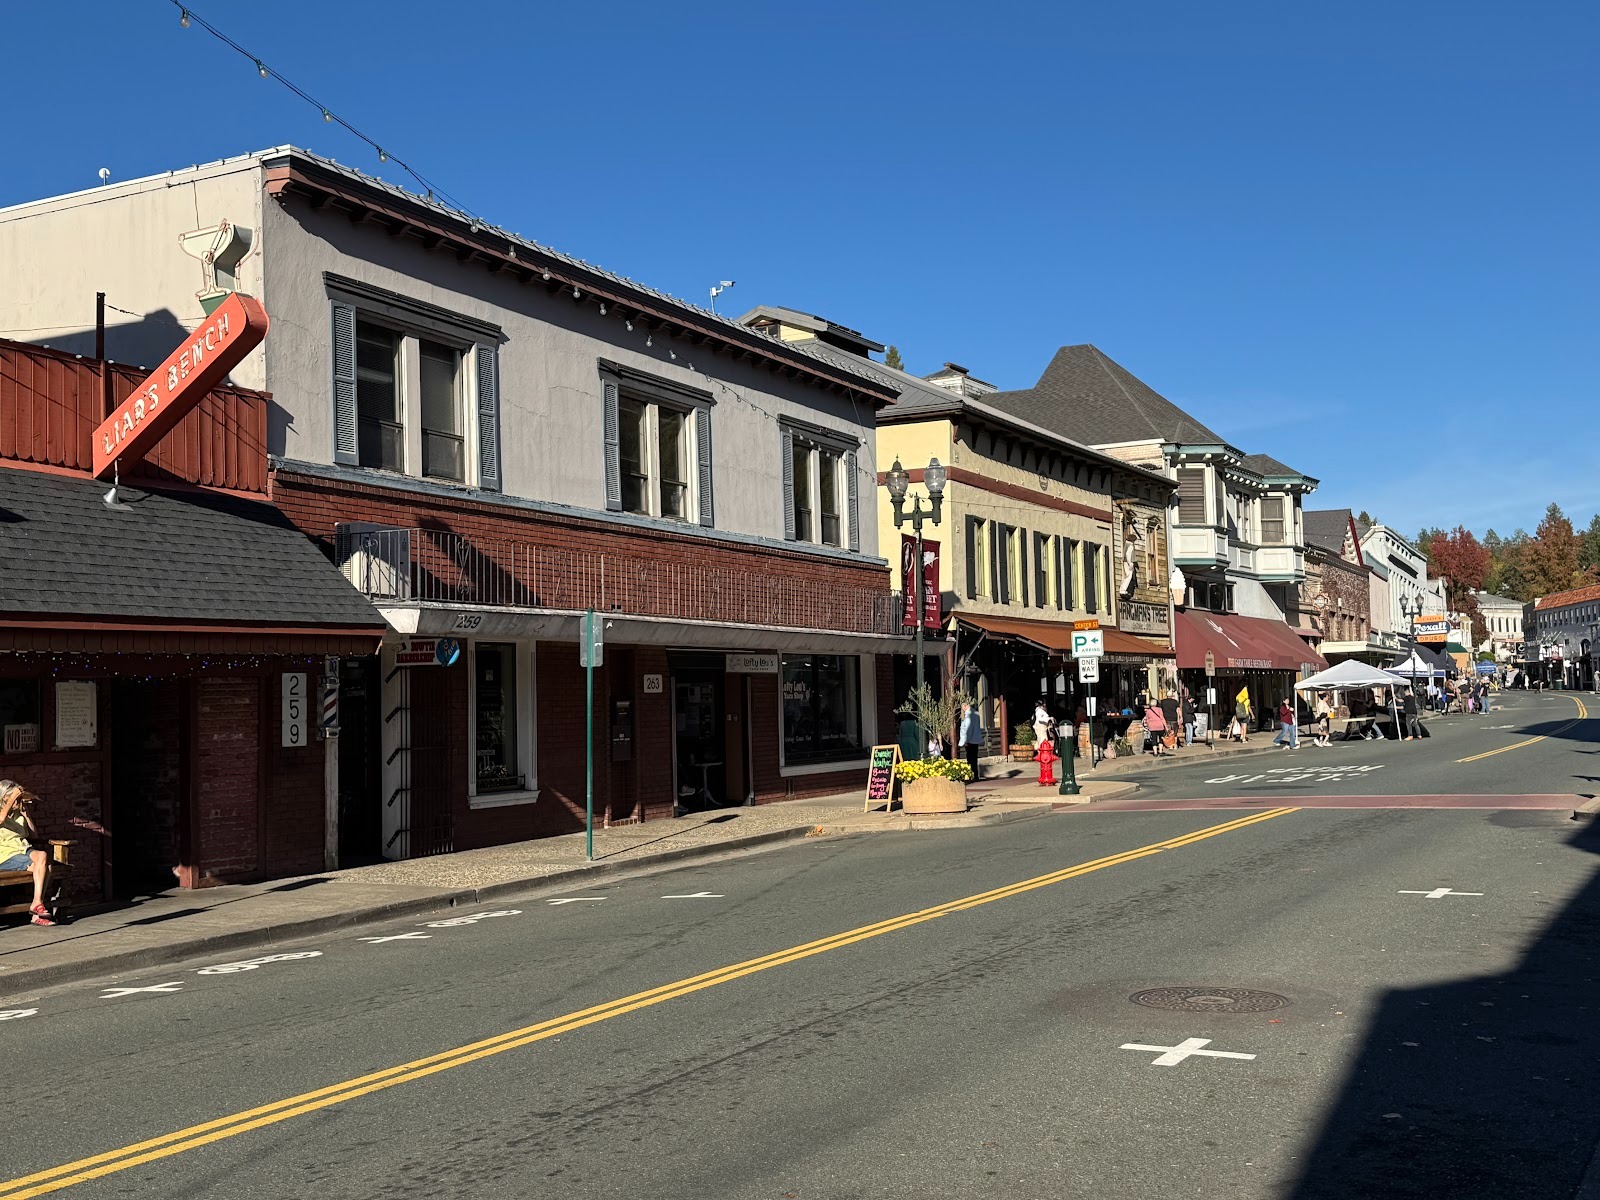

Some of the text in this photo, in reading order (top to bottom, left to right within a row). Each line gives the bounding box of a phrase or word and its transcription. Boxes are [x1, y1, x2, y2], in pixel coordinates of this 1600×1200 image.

[165, 312, 230, 392] BENCH
[456, 615, 482, 629] 259
[1151, 606, 1167, 623] TREE
[1413, 621, 1448, 635] Rexall
[1074, 636, 1101, 653] PARKING
[743, 657, 774, 667] Lofty Lou's
[646, 677, 660, 690] 263
[289, 675, 299, 744] 259
[7, 729, 21, 750] NO
